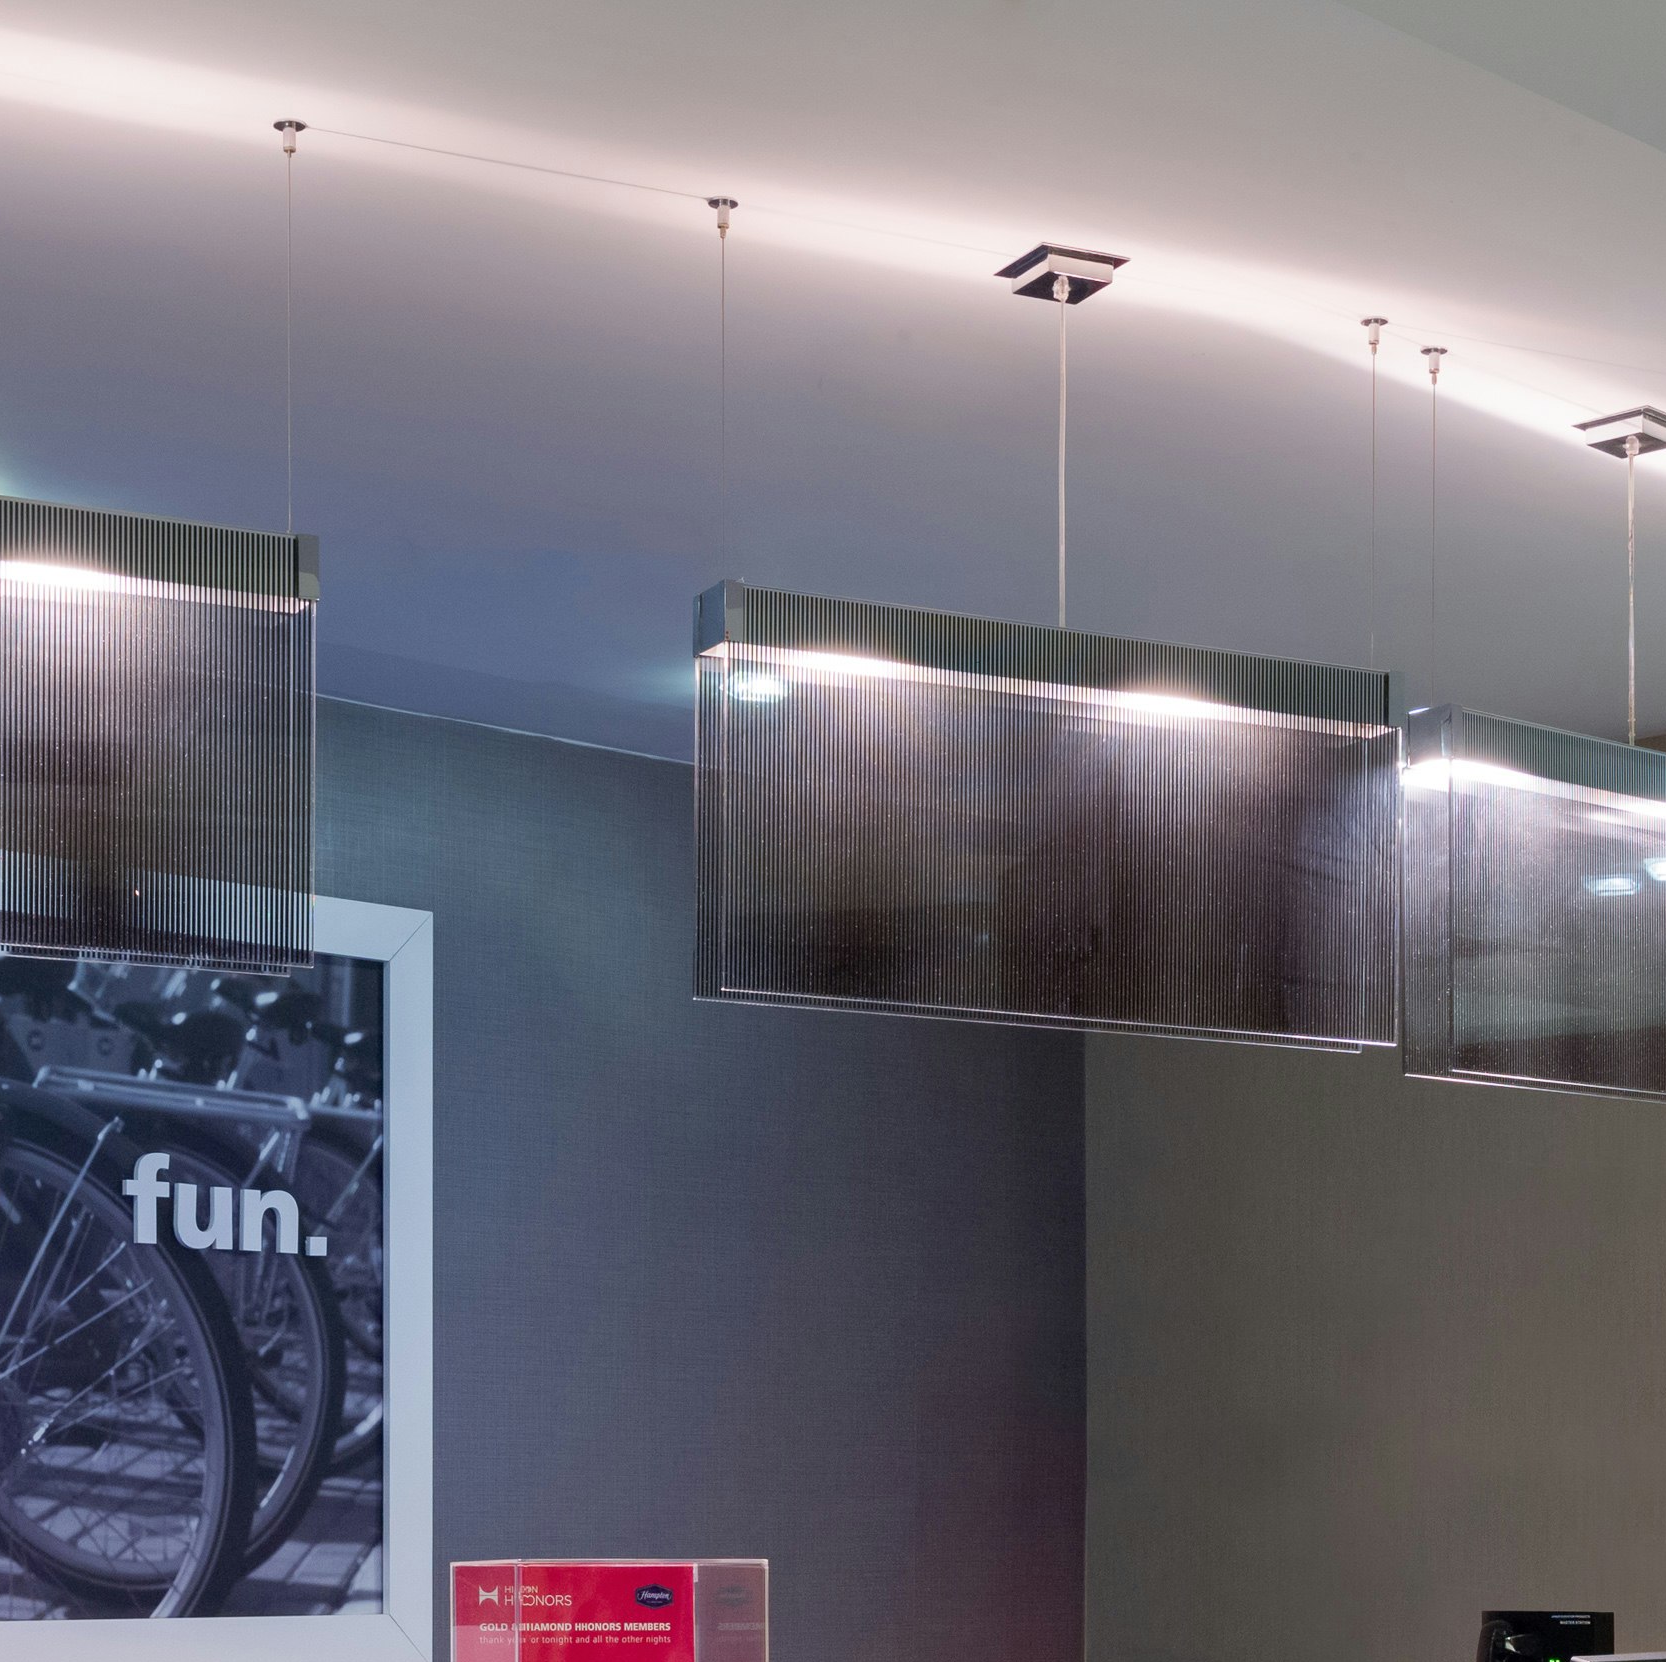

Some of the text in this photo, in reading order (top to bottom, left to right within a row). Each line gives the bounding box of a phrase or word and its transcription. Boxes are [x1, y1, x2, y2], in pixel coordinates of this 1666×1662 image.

[122, 1152, 328, 1257] fun.
[504, 1594, 572, 1607] HONORS
[637, 1590, 672, 1601] Hampton
[479, 1622, 509, 1632] GOLD
[521, 1622, 573, 1632] IAMOND
[574, 1622, 622, 1632] HHONORS
[623, 1622, 672, 1632] MEMBERS
[479, 1635, 504, 1644] thank
[541, 1635, 573, 1646] tonight
[575, 1635, 591, 1644] and
[592, 1635, 604, 1644] all
[605, 1635, 620, 1644] the
[621, 1635, 644, 1644] other
[645, 1635, 672, 1646] nights
